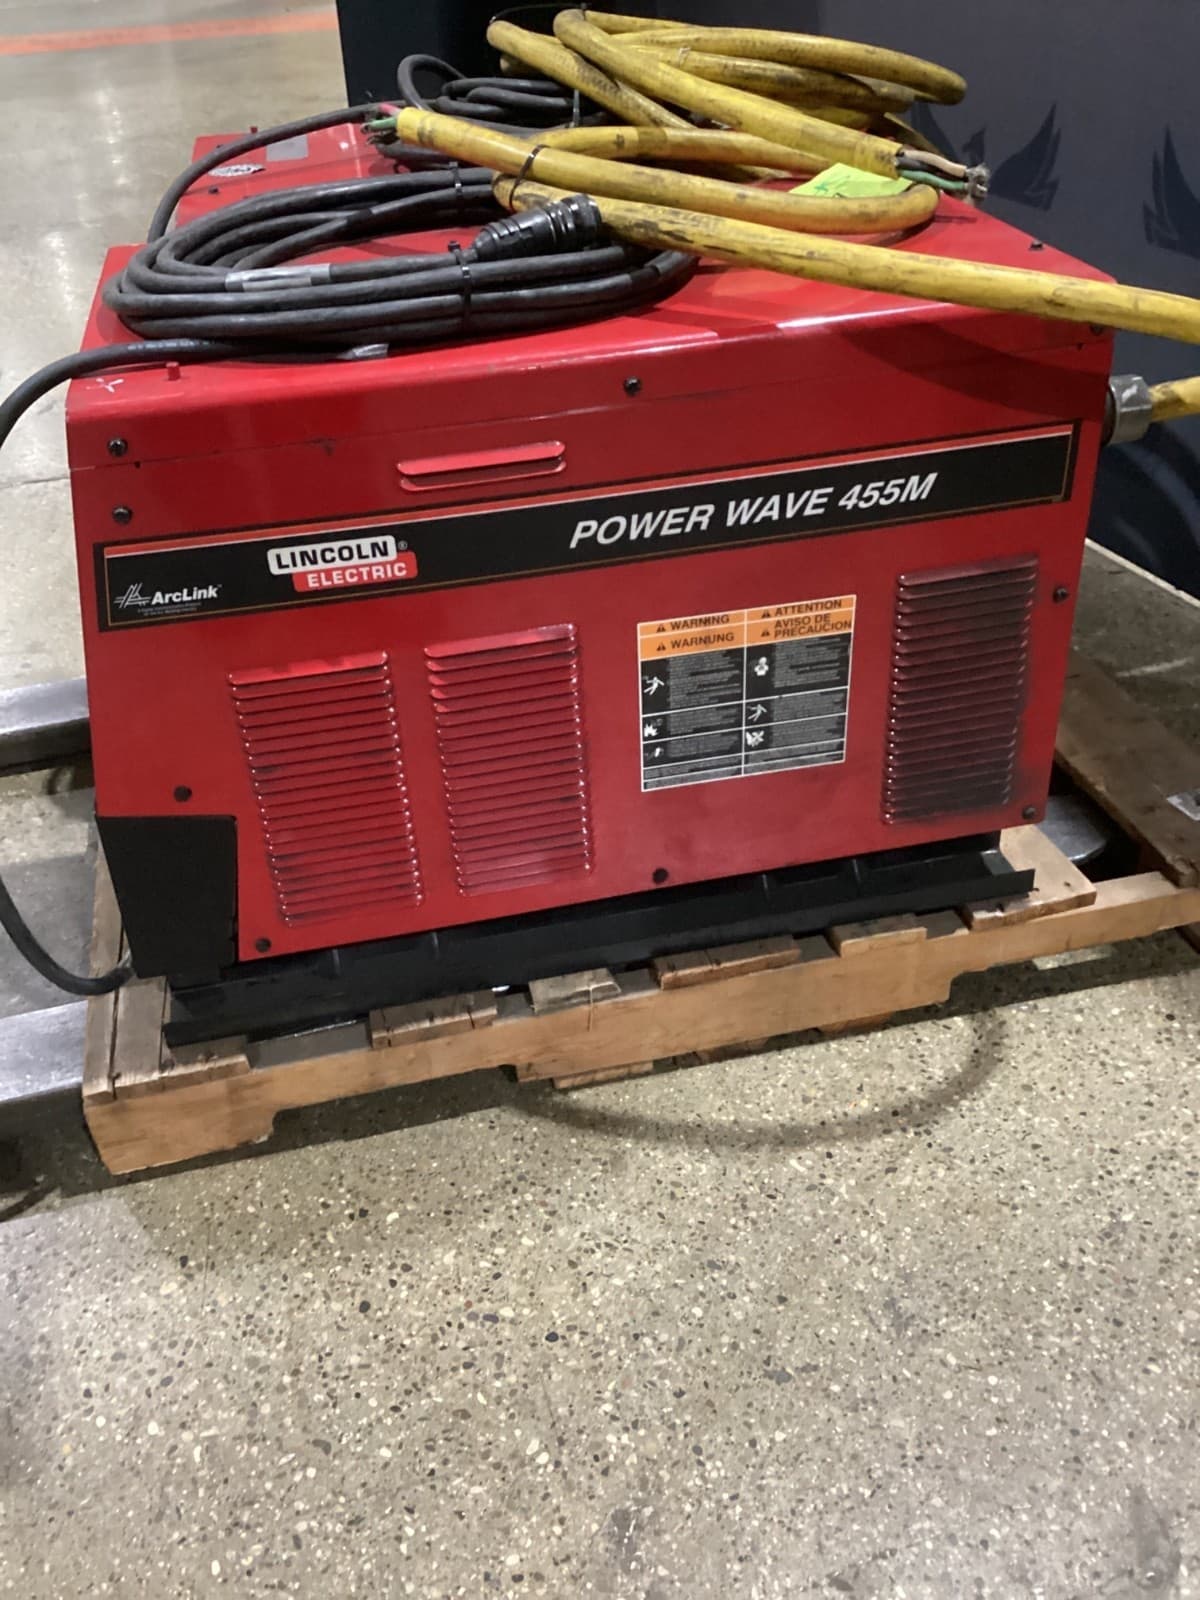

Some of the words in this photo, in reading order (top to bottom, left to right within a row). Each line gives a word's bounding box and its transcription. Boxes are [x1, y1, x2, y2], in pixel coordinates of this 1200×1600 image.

[569, 503, 715, 549] POWER
[725, 487, 833, 527] WAVE
[838, 472, 938, 511] 455M
[275, 541, 389, 570] LINCOLN
[306, 562, 408, 588] ELECTRIC
[151, 585, 218, 605] ArcLink
[774, 599, 842, 616] ATTENTION
[670, 614, 730, 631] WARNING
[774, 615, 812, 630] AVISO
[814, 613, 831, 625] DE
[774, 620, 851, 638] PRECAUCION
[670, 631, 735, 650] WARNUNG
